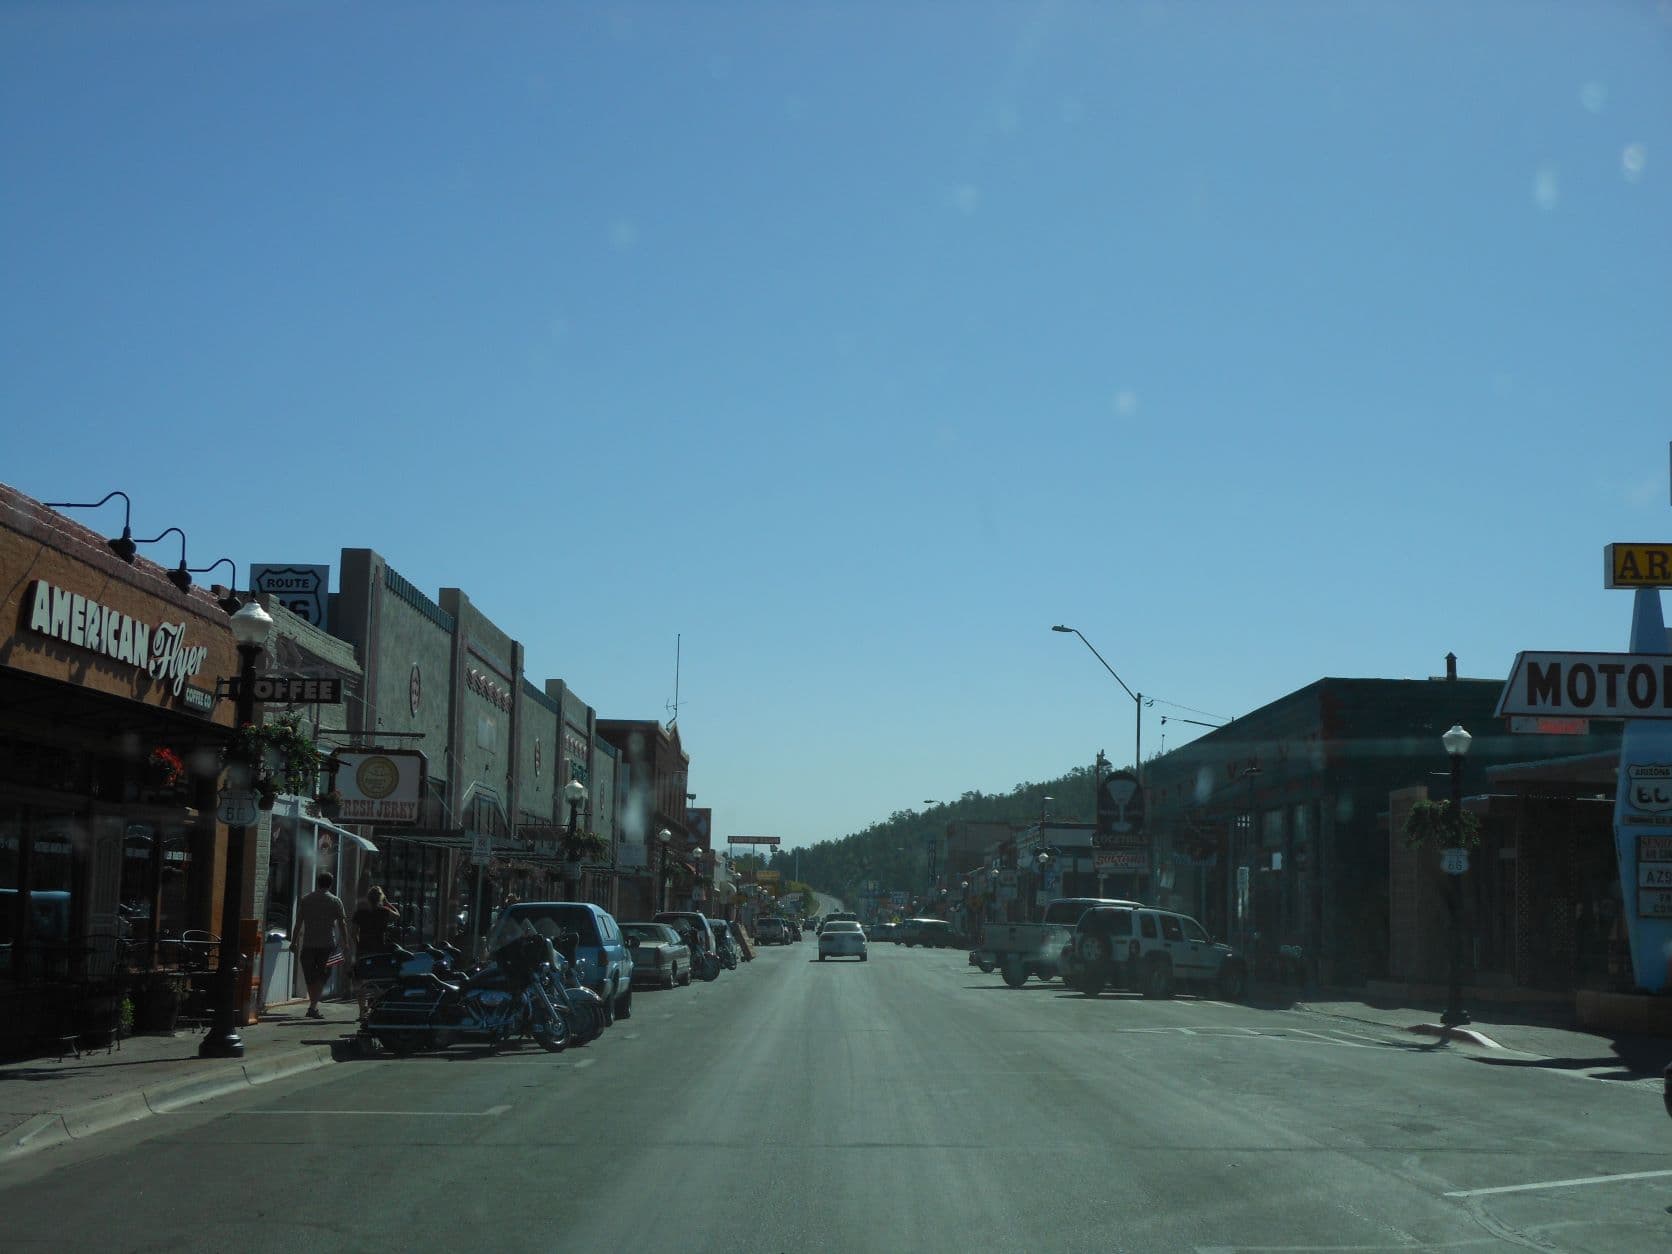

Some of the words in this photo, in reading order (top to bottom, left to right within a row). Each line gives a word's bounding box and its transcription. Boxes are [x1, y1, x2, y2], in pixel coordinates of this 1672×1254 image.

[266, 578, 310, 589] ROUTE
[31, 579, 151, 669] AMERICAN
[149, 621, 209, 696] Flyer
[344, 799, 375, 818] RESH
[377, 799, 416, 820] JERKY
